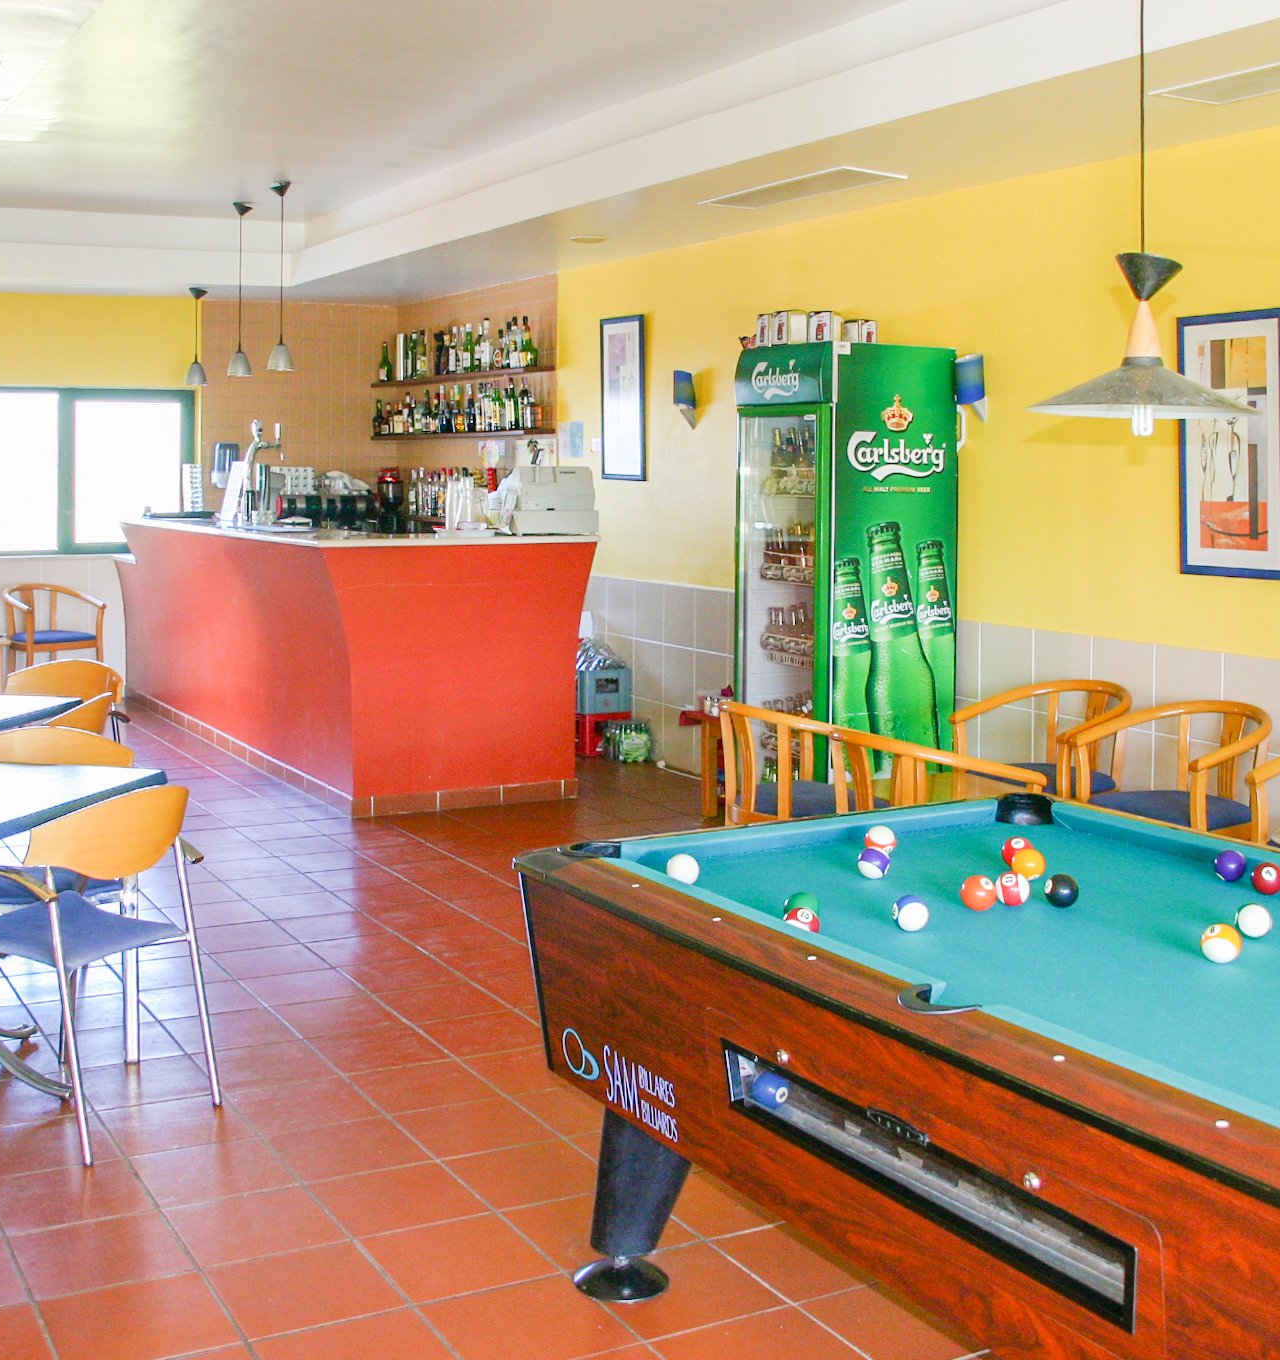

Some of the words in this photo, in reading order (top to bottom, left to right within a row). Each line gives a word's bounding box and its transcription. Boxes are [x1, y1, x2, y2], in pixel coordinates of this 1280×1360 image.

[751, 359, 800, 400] Carlsberg
[847, 431, 946, 482] Carlsberg
[832, 617, 869, 643] Carlsberg
[871, 594, 914, 625] Carlsberg
[917, 601, 952, 625] Carlsberg
[603, 1044, 640, 1118] SAM
[638, 1064, 676, 1108] BILLARES
[641, 1099, 678, 1143] BILLIARDS
